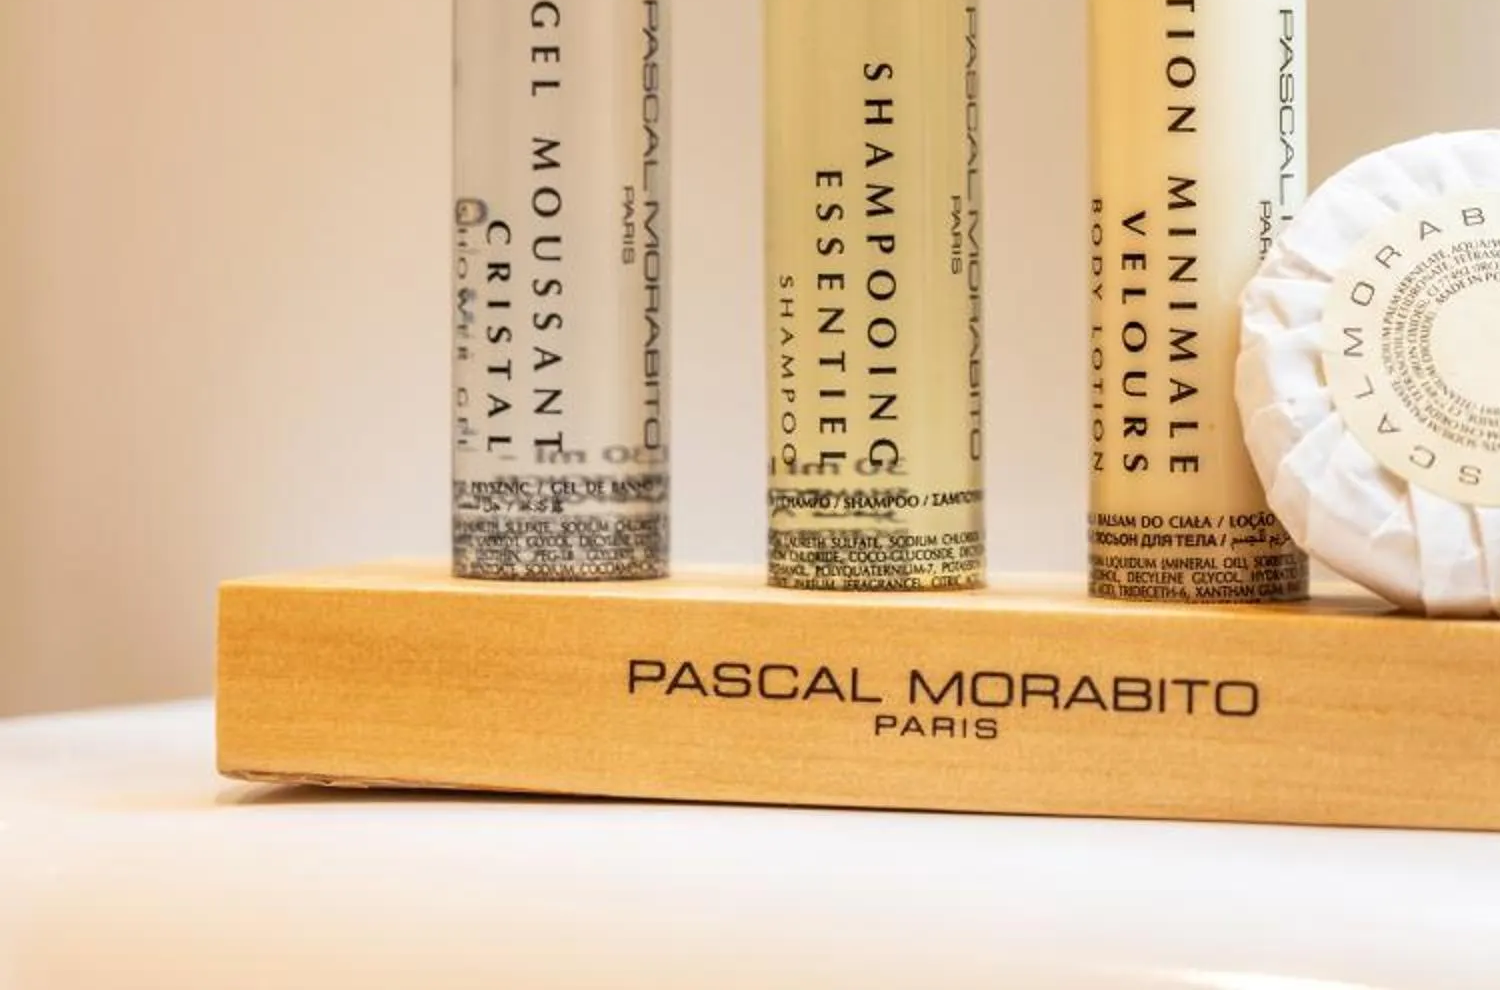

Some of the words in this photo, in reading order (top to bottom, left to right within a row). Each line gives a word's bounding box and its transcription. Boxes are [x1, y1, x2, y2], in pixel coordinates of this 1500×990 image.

[531, 0, 562, 98] GEL
[1278, 8, 1295, 205] PASCAL
[621, 184, 635, 266] PARIS
[863, 61, 900, 470] SHAMPOOING
[949, 195, 962, 275] PARIS
[1090, 198, 1105, 301] BODY
[1258, 199, 1274, 261] PAR
[486, 219, 513, 453] CRISTAL
[531, 137, 564, 456] MOUSSANT
[642, 200, 662, 451] MORABITO
[815, 169, 848, 469] ESSENTIEL
[1120, 210, 1149, 474] VELOURS
[1167, 175, 1199, 475] MINIMALE
[780, 275, 798, 467] SHAMPOO
[1090, 324, 1105, 472] LOTION
[843, 495, 920, 509] SHAMPOO
[1141, 515, 1164, 529] DO
[1168, 515, 1213, 529] CIAŁA
[1141, 533, 1173, 548] ДЛЯ
[1174, 533, 1218, 547] ТЕЛА
[627, 658, 883, 703] PASCAL
[908, 668, 1260, 717] MORABITO
[874, 714, 998, 739] PARIS
